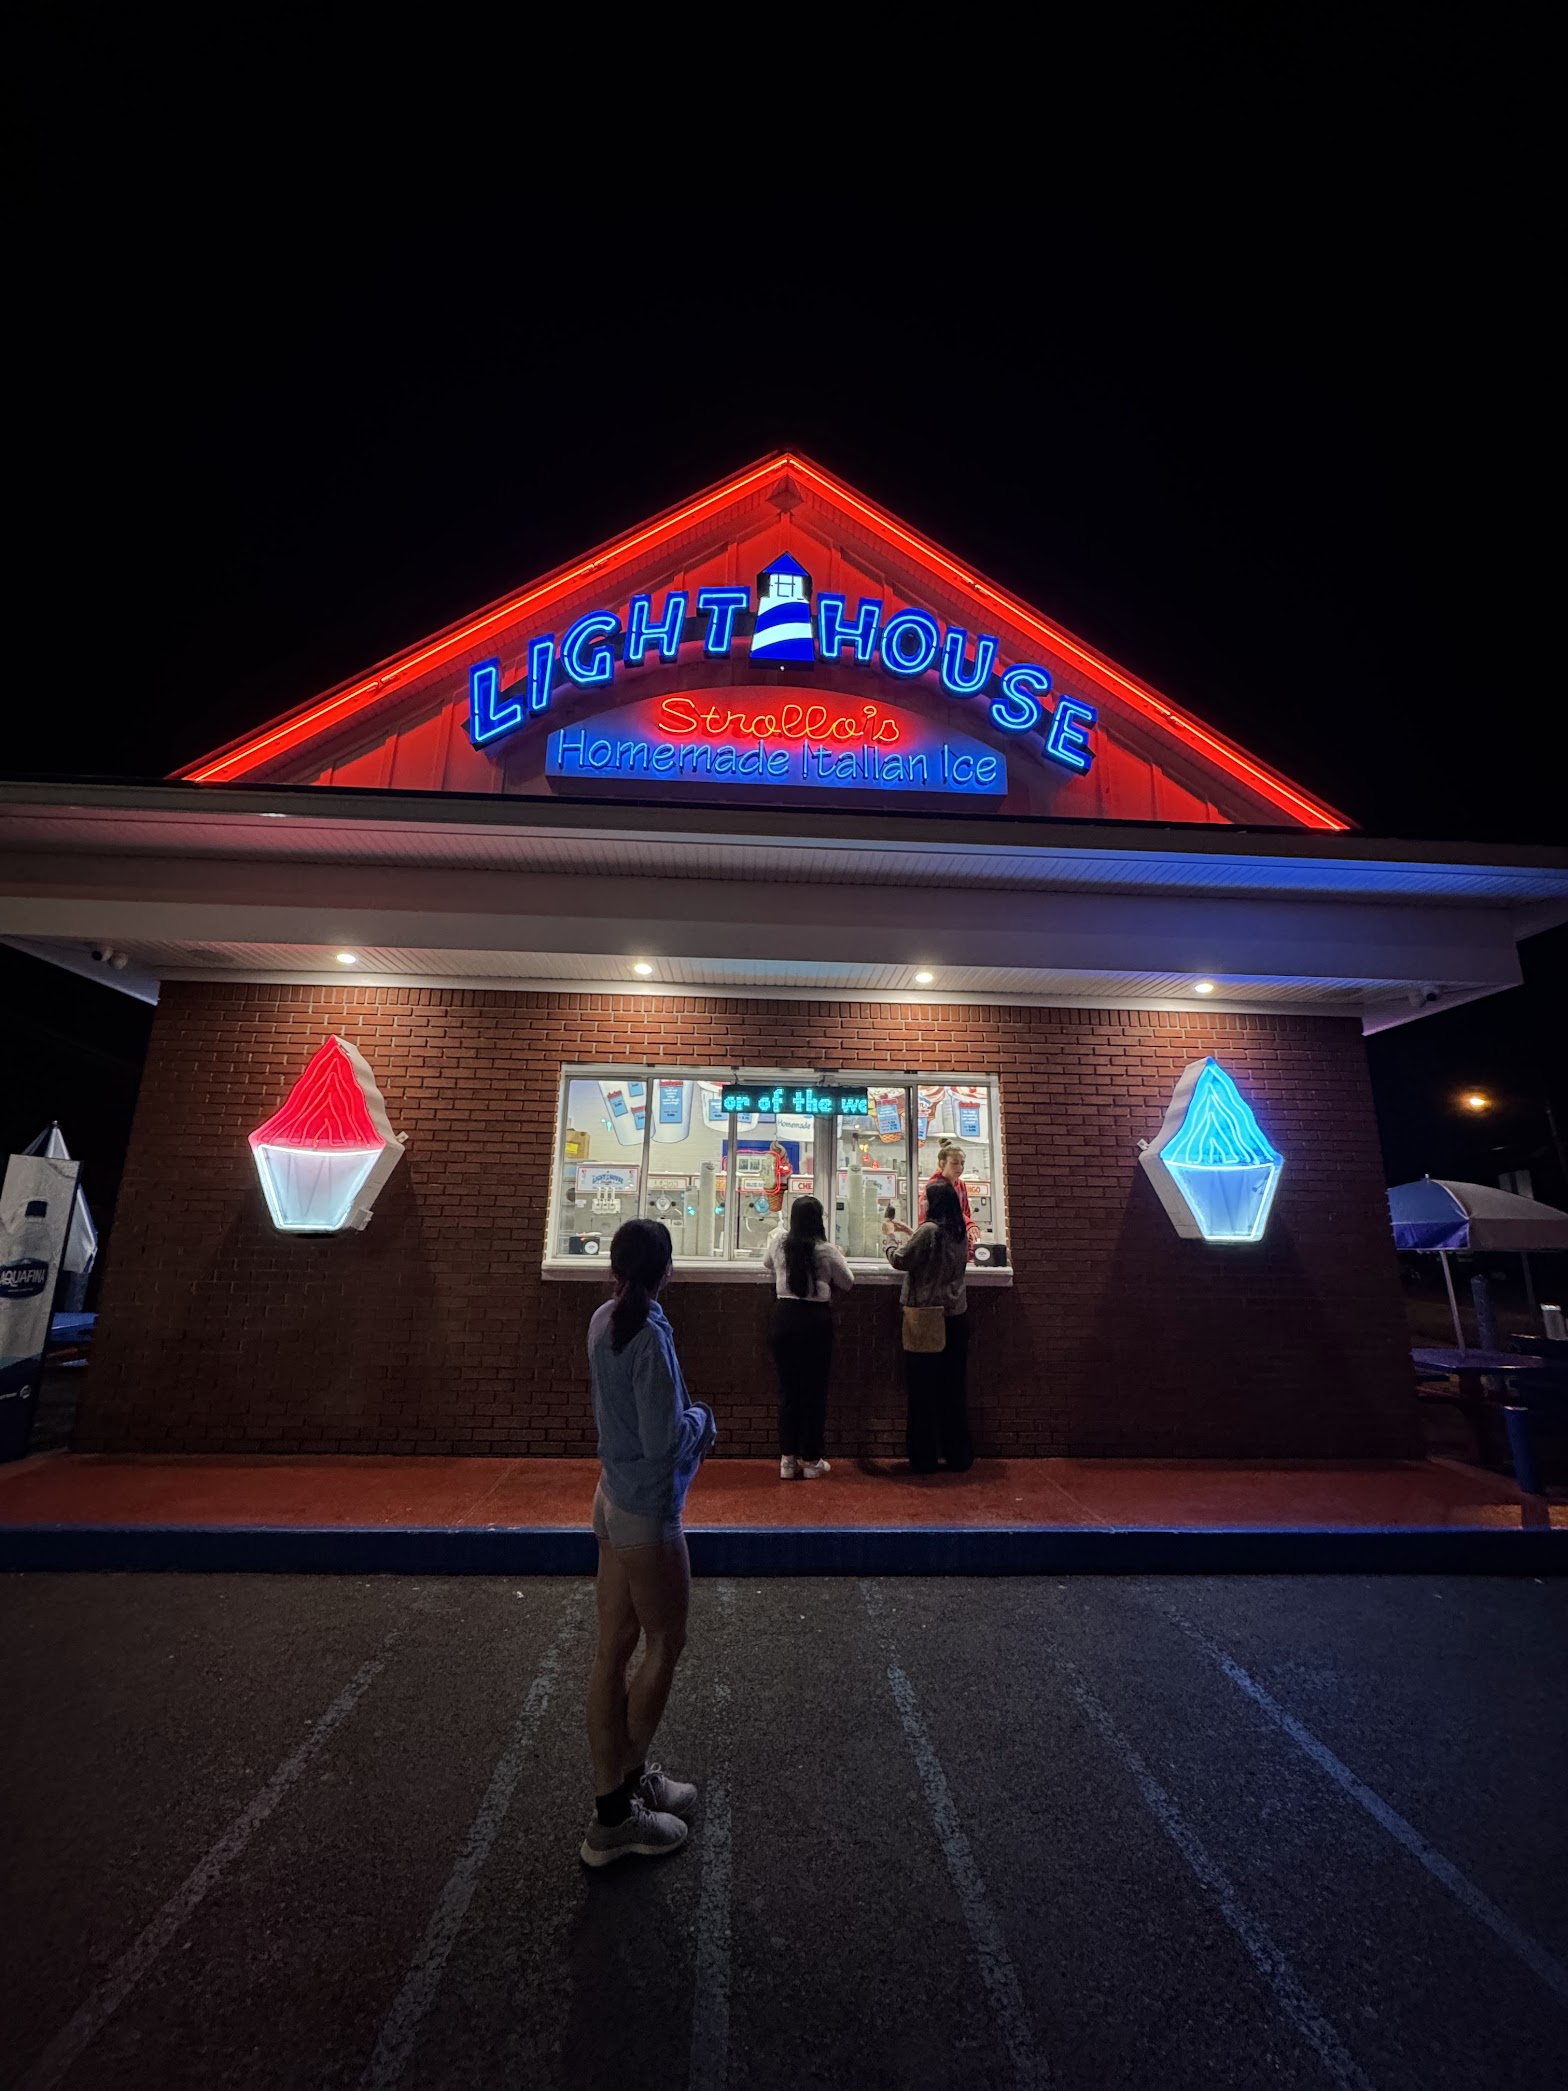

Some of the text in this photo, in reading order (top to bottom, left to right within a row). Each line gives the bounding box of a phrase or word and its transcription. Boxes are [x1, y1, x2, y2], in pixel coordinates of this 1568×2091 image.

[470, 586, 1098, 777] LIGHT HOUSE
[658, 697, 900, 742] Strollo's
[557, 729, 997, 784] Homemade Italian Ice
[758, 1087, 784, 1112] of
[793, 1089, 832, 1113] the
[777, 1119, 811, 1129] Homemade
[0, 1269, 46, 1288] AQUAFINA
